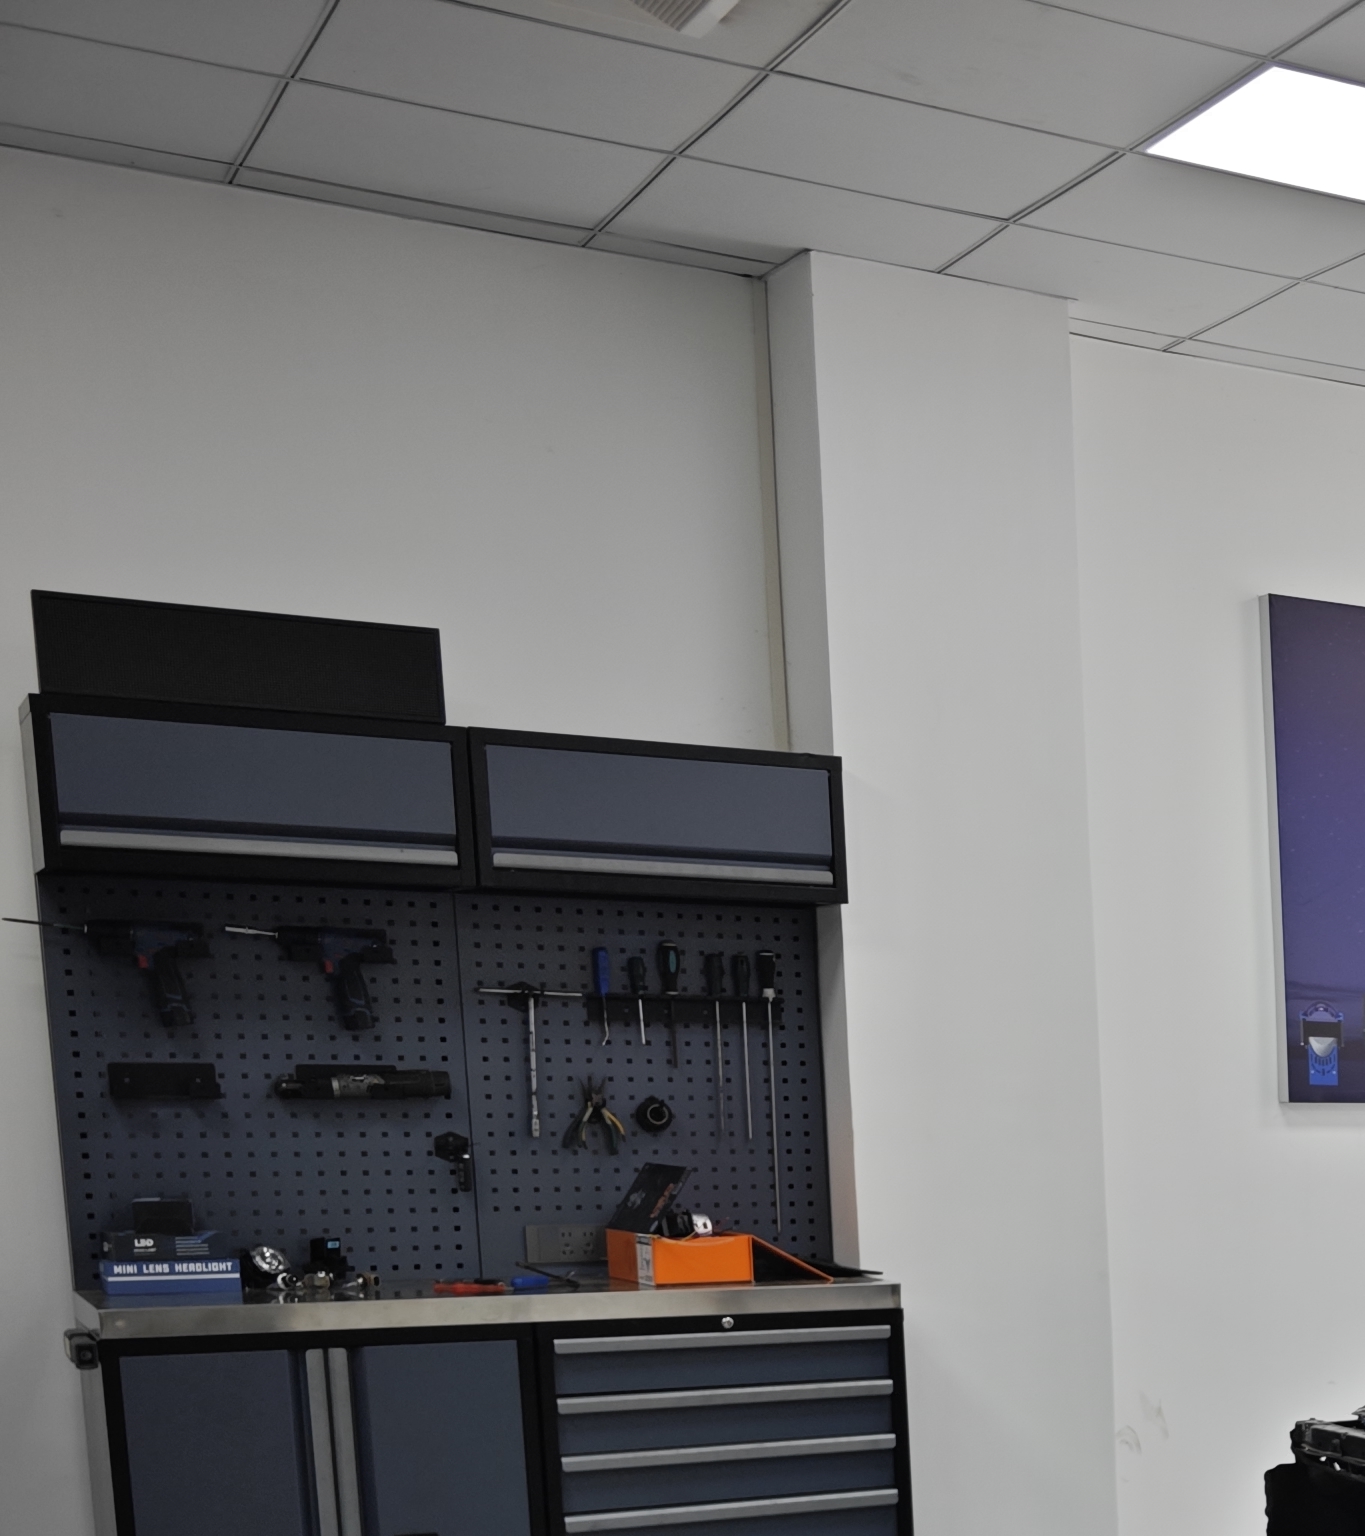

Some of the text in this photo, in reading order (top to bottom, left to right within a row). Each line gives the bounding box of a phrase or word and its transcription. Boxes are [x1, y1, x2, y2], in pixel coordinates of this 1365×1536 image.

[114, 1262, 233, 1274] MINI LENS HEADLIGHT
